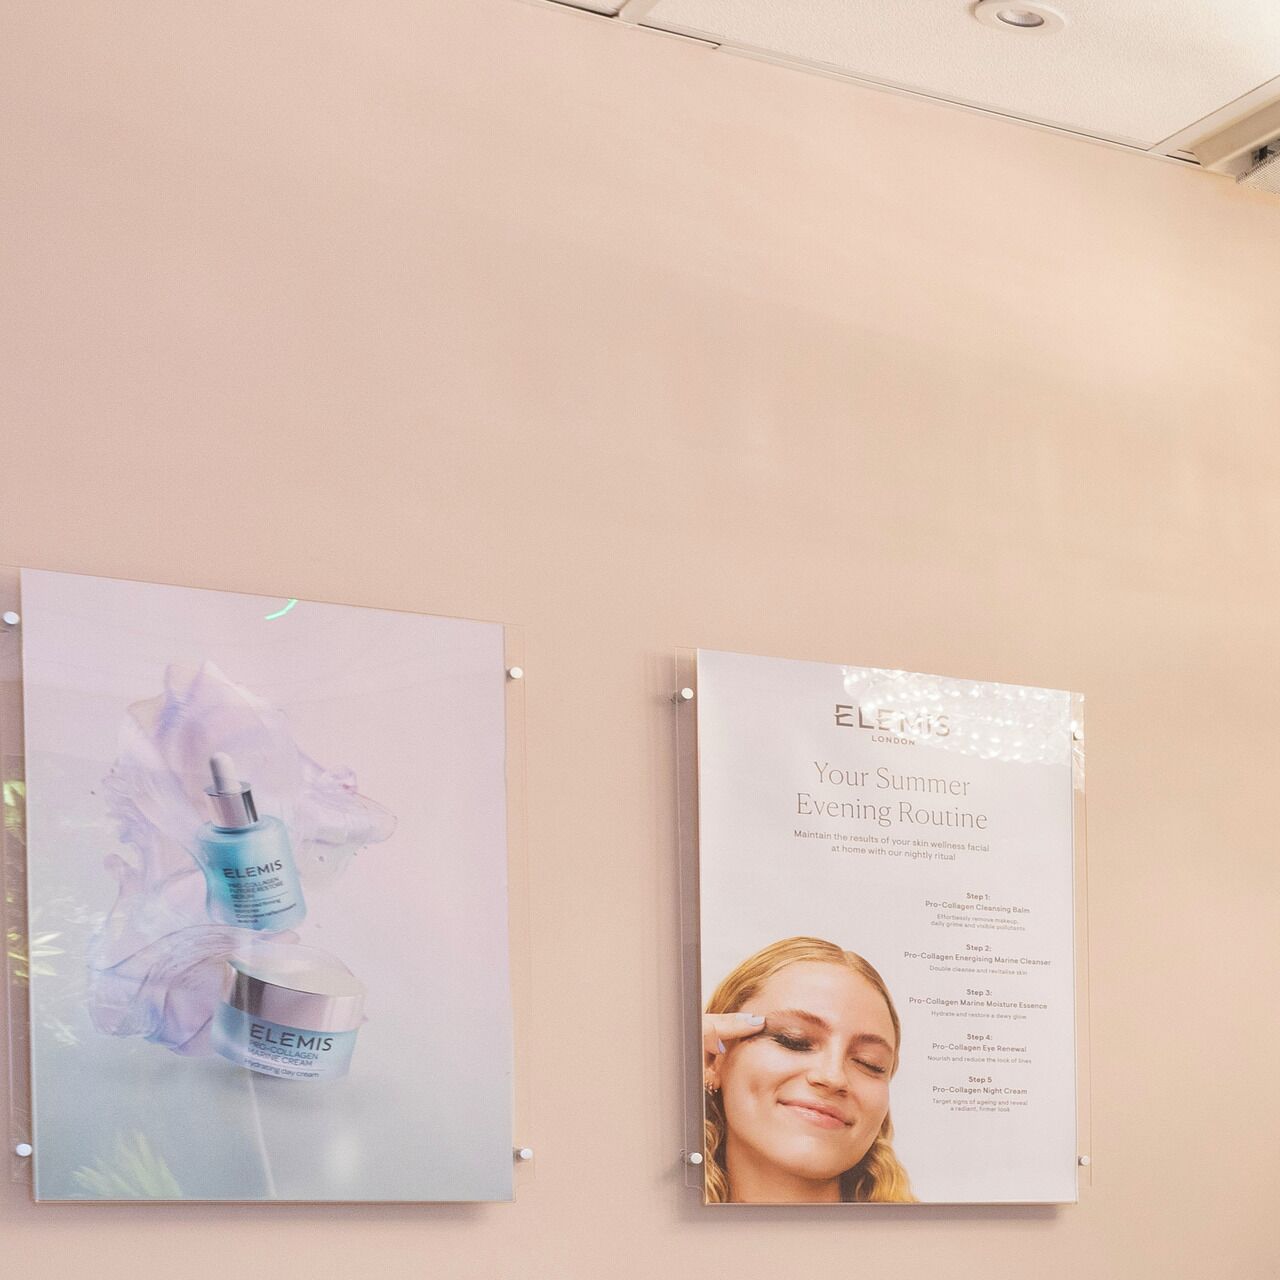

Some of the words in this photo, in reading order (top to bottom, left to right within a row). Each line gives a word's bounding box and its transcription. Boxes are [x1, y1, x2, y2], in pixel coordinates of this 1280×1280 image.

[834, 704, 950, 737] ELEMIS
[872, 735, 915, 745] LONDON
[814, 761, 869, 787] Your
[876, 767, 970, 796] Summer
[797, 792, 892, 827] Evening
[900, 801, 987, 829] Routine
[794, 830, 831, 840] Maintain
[834, 833, 848, 841] the
[850, 835, 878, 843] results
[912, 839, 929, 847] skin
[930, 841, 965, 850] wellness
[967, 843, 989, 852] facial
[842, 845, 866, 854] home
[868, 847, 886, 855] with
[904, 850, 932, 860] nightly
[934, 853, 956, 861] ritual
[223, 859, 283, 879] ELEMIS
[966, 892, 984, 901] Step
[925, 900, 975, 912] Pro-Collagen
[975, 904, 1011, 914] Cleansing
[1012, 906, 1030, 914] Balm
[966, 944, 983, 952] Step
[904, 951, 954, 962] Pro-Collagen
[955, 954, 993, 964] Energising
[994, 957, 1019, 965] Marine
[1020, 958, 1051, 966] Cleanser
[966, 989, 984, 997] Step
[909, 997, 959, 1007] Pro-Collagen
[986, 1001, 1018, 1009] Moisture
[250, 1023, 334, 1052] ELEMIS
[967, 1033, 984, 1042] Step
[249, 1040, 319, 1060] PRO-COLLAGEN
[932, 1042, 981, 1052] Pro-Collagen
[982, 1044, 996, 1052] Eye
[997, 1045, 1027, 1053] Renewal
[281, 1057, 313, 1066] CREAM
[281, 1068, 296, 1077] day
[968, 1076, 986, 1084] Step
[932, 1086, 981, 1095] Pro-Collagen
[982, 1087, 1002, 1096] Night
